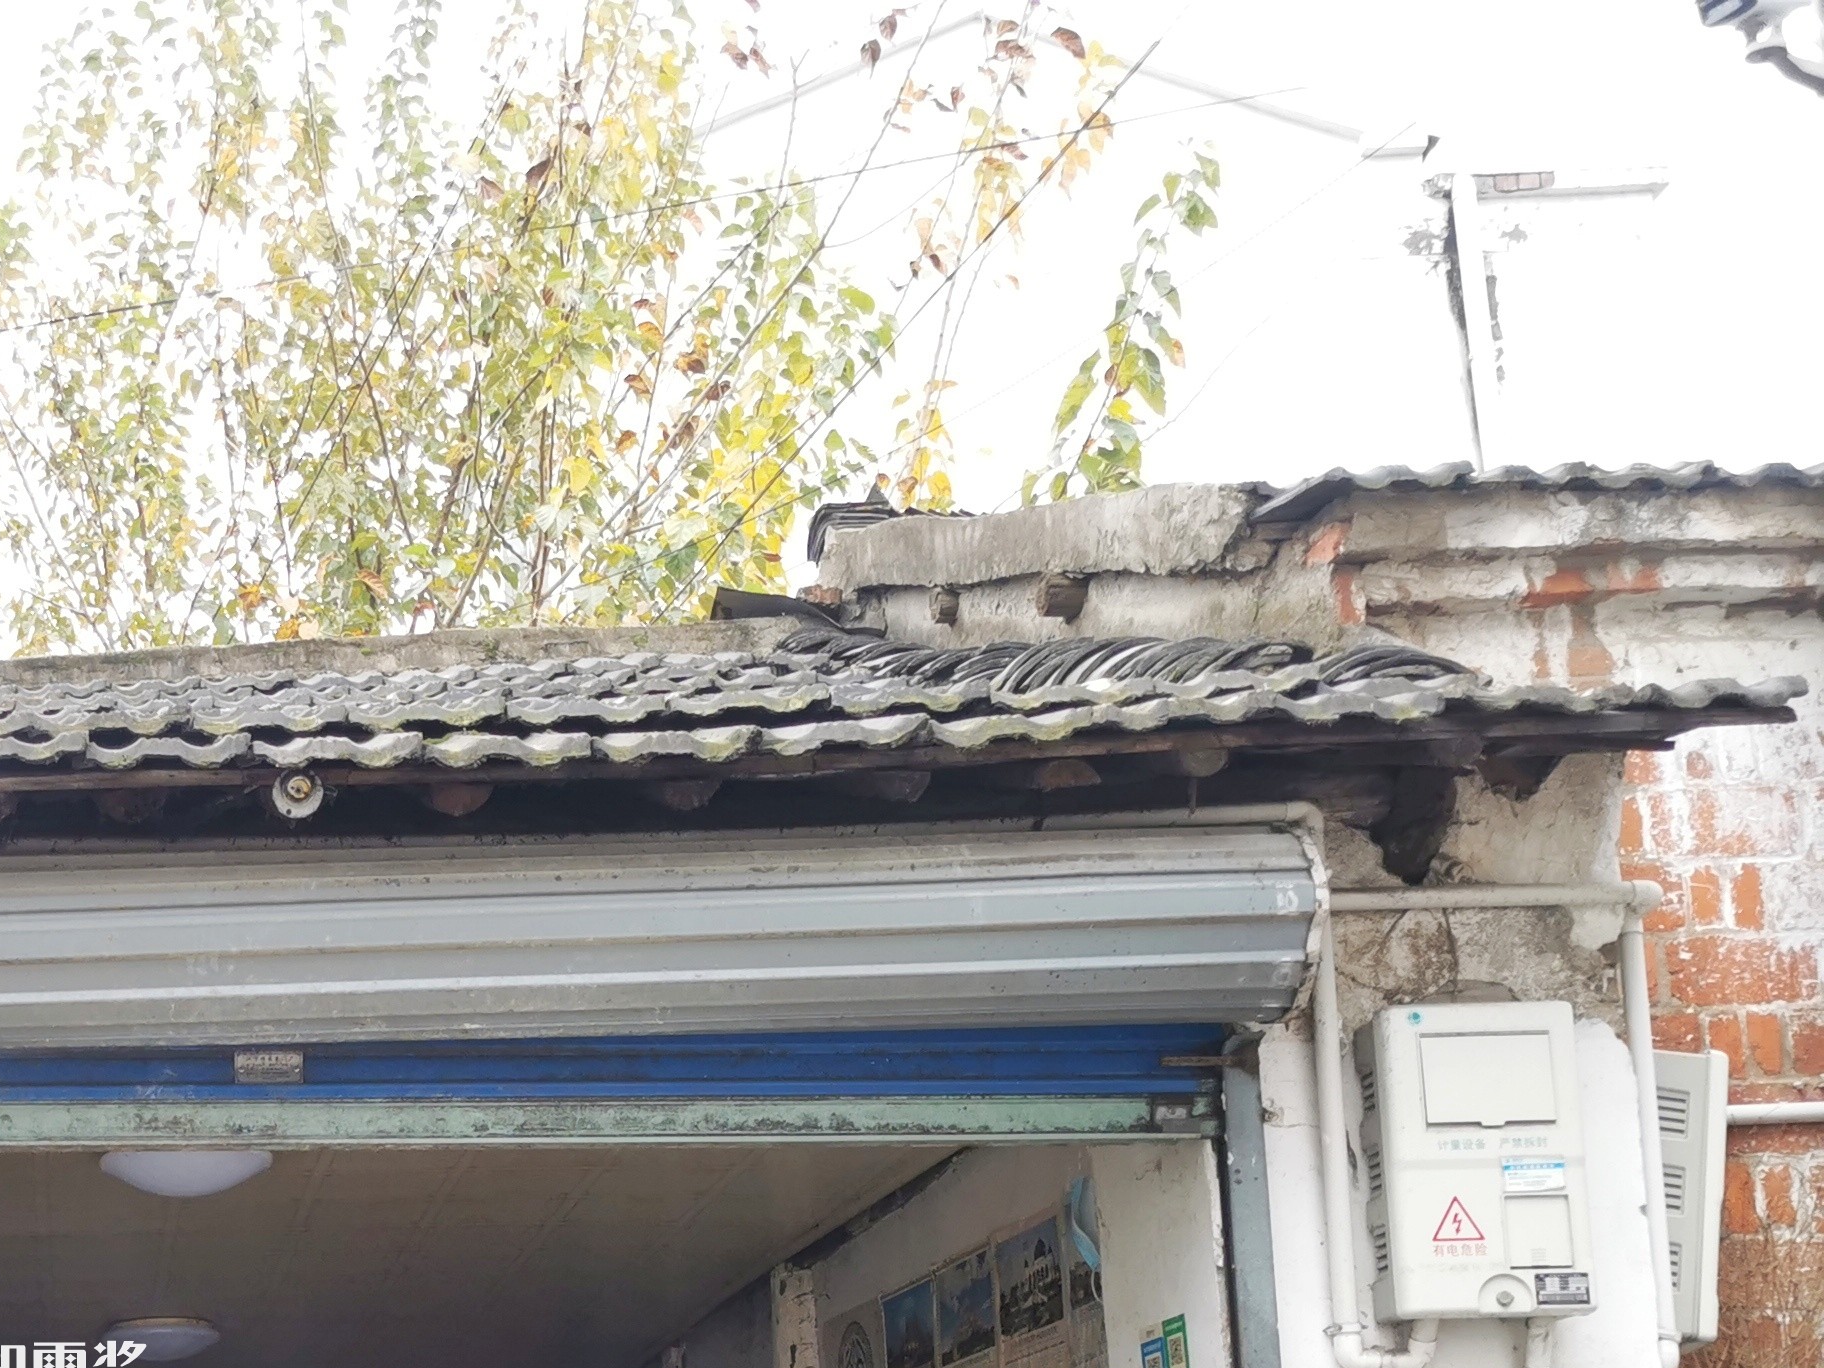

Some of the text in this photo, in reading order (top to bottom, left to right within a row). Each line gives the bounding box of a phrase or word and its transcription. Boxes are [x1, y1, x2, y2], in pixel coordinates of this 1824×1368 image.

[1437, 1136, 1549, 1151] 计量设备 严禁拆封
[1433, 1243, 1488, 1257] 有电危险
